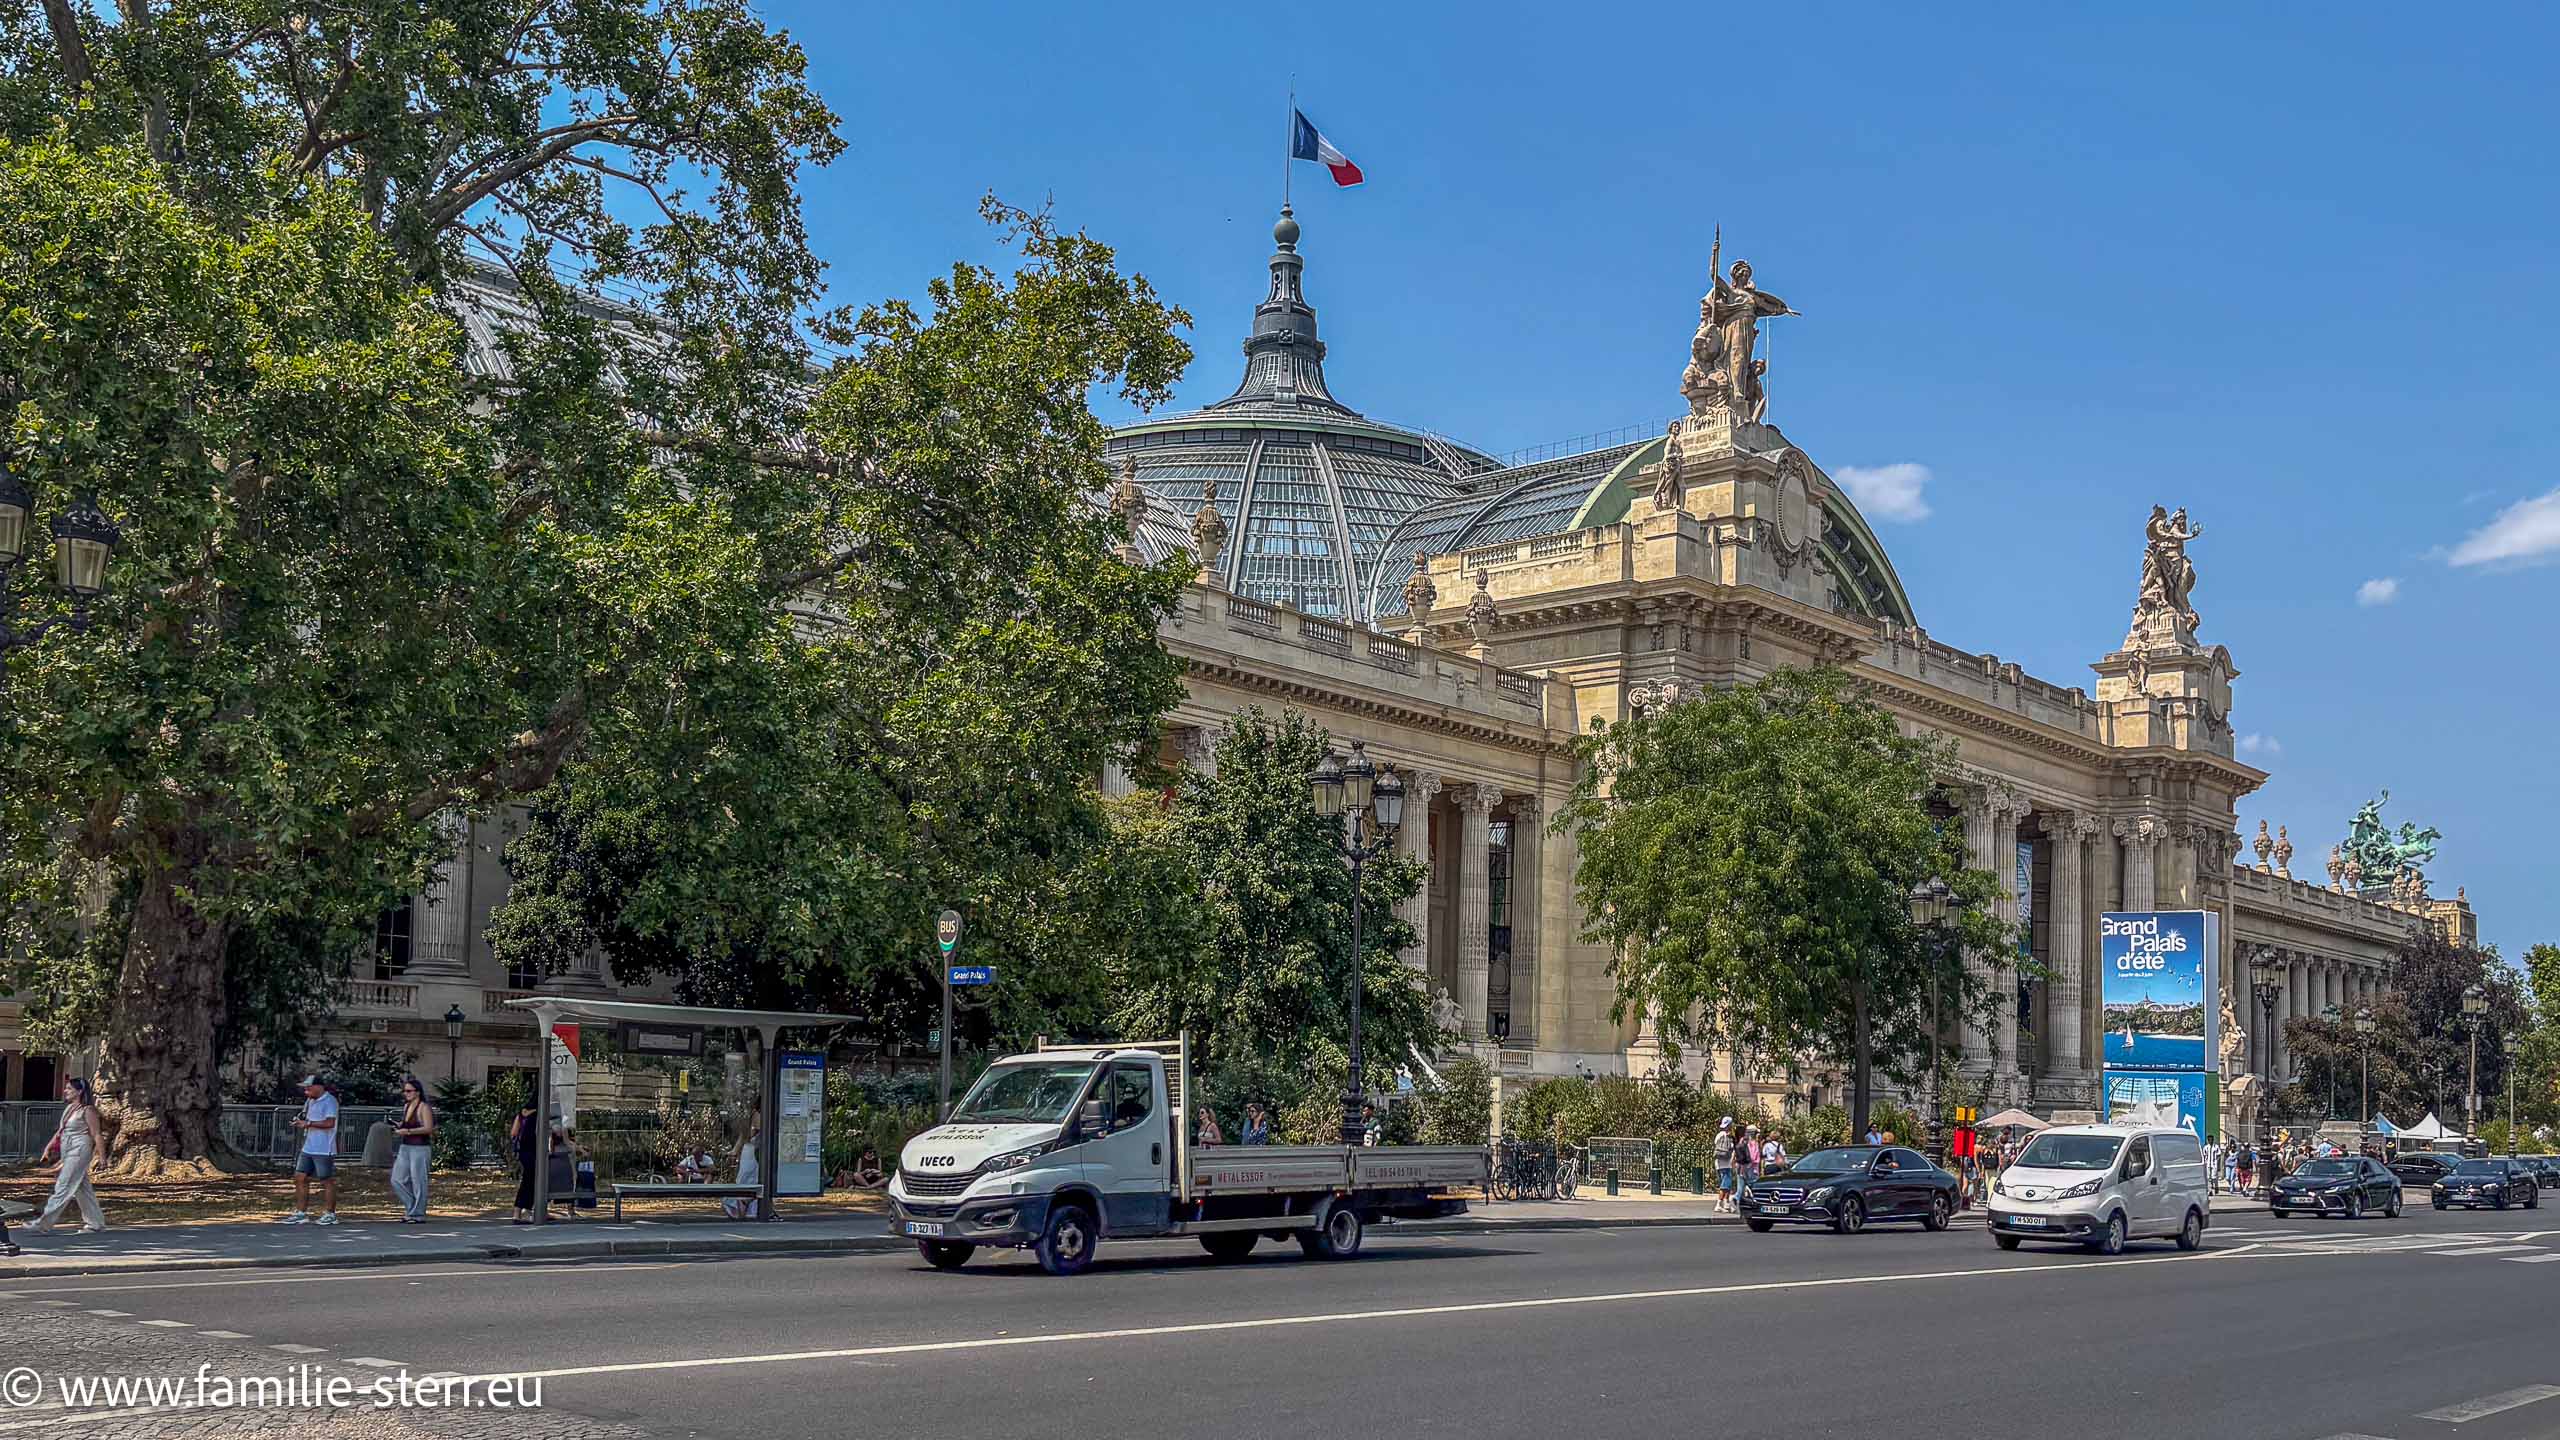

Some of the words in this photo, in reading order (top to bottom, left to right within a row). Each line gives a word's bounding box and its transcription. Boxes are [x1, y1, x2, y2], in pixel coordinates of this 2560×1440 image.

[940, 920, 956, 933] BUS
[2102, 917, 2157, 936] Grand
[2130, 932, 2187, 952] Palais
[2116, 951, 2165, 970] d'été
[953, 971, 969, 980] Grand
[920, 1156, 955, 1167] IVECO
[1217, 1171, 1265, 1185] METALESSOR
